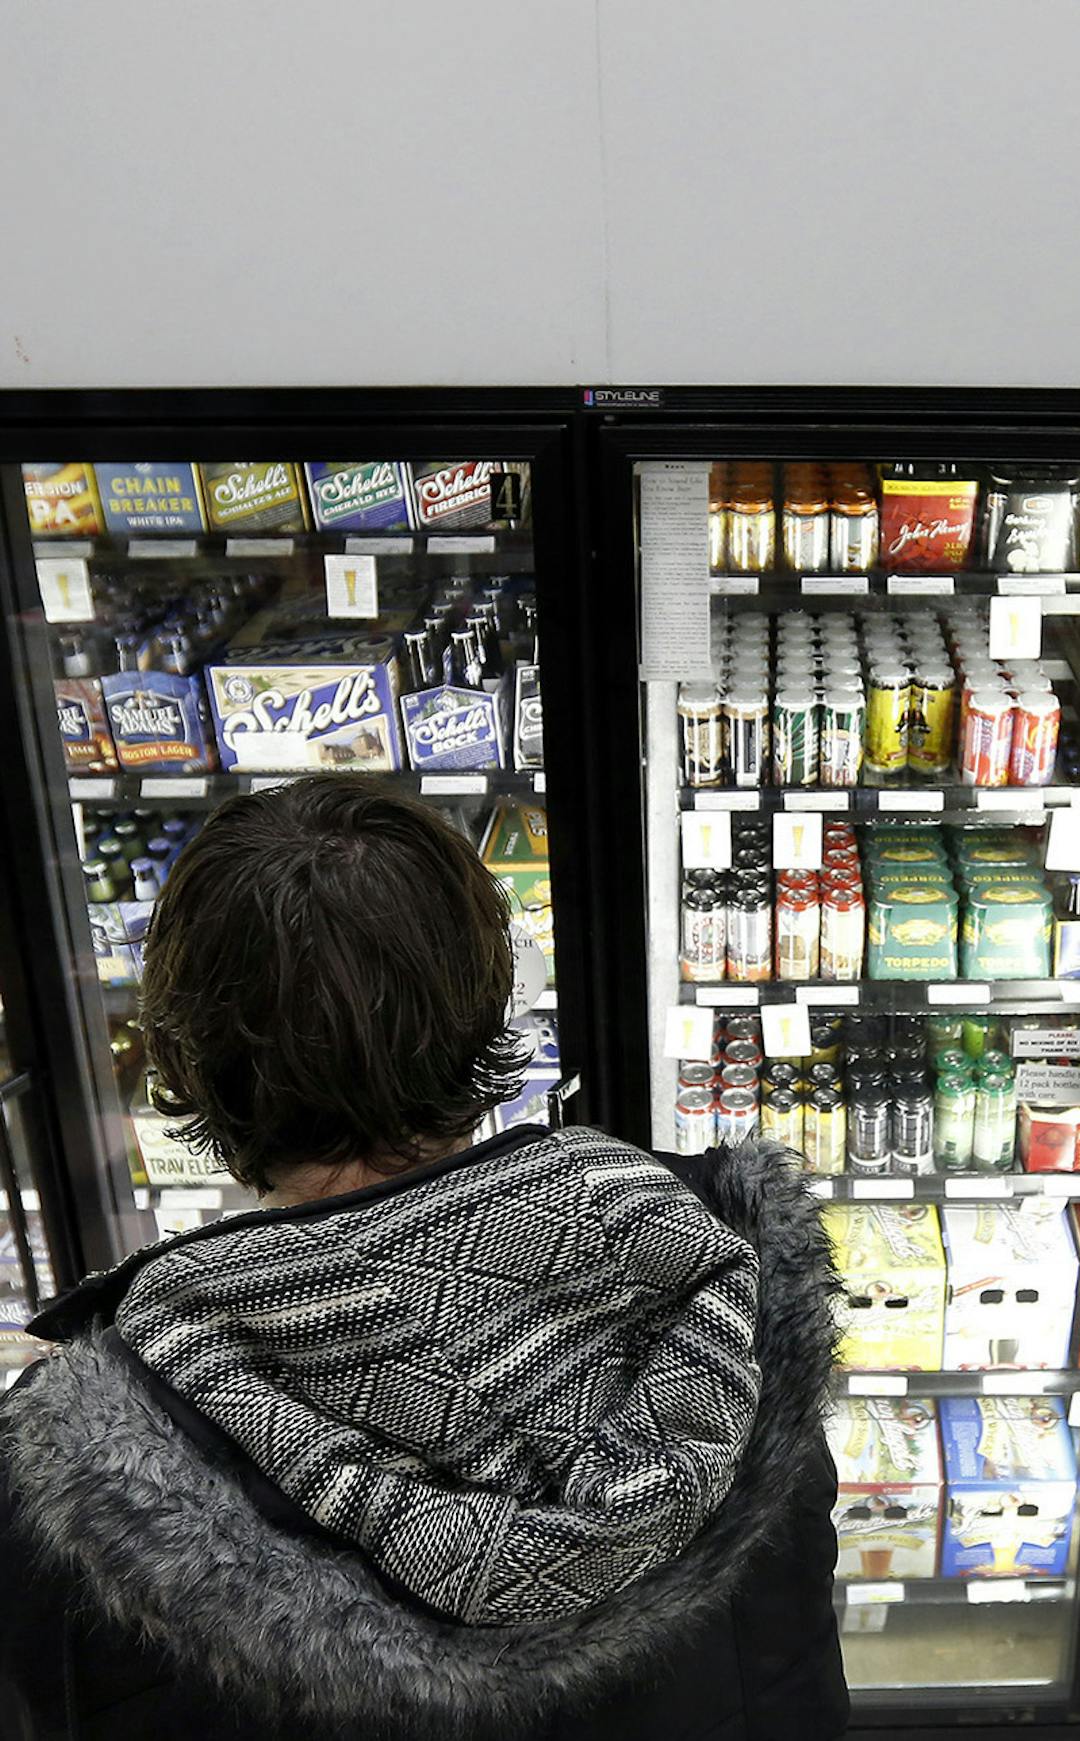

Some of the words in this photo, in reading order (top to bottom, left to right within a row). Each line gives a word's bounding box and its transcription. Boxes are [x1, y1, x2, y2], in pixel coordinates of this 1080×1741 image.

[594, 390, 660, 401] STYLELINE
[110, 477, 182, 495] CHAIN
[109, 498, 194, 513] BREAKER
[323, 494, 373, 516] EMERALD
[375, 485, 397, 499] RYE
[426, 484, 491, 517] FIREBRIC
[495, 475, 518, 519] 4
[127, 516, 163, 526] WHITE
[165, 516, 185, 526] IPA
[888, 522, 930, 555] John
[928, 519, 970, 542] Henry
[111, 704, 182, 724] SAMUEL
[119, 717, 177, 736] ADAMS
[414, 707, 488, 745] Schell's
[431, 731, 478, 755] BOCK
[121, 748, 158, 761] BOSTON
[159, 745, 194, 758] LAGER
[884, 956, 950, 969] TORPEDO
[1020, 1068, 1047, 1078] Please
[1048, 1069, 1077, 1079] handle
[1020, 1079, 1029, 1088] 12
[1031, 1079, 1051, 1090] pack
[1053, 1080, 1080, 1089] bottles
[1018, 1090, 1036, 1099] with
